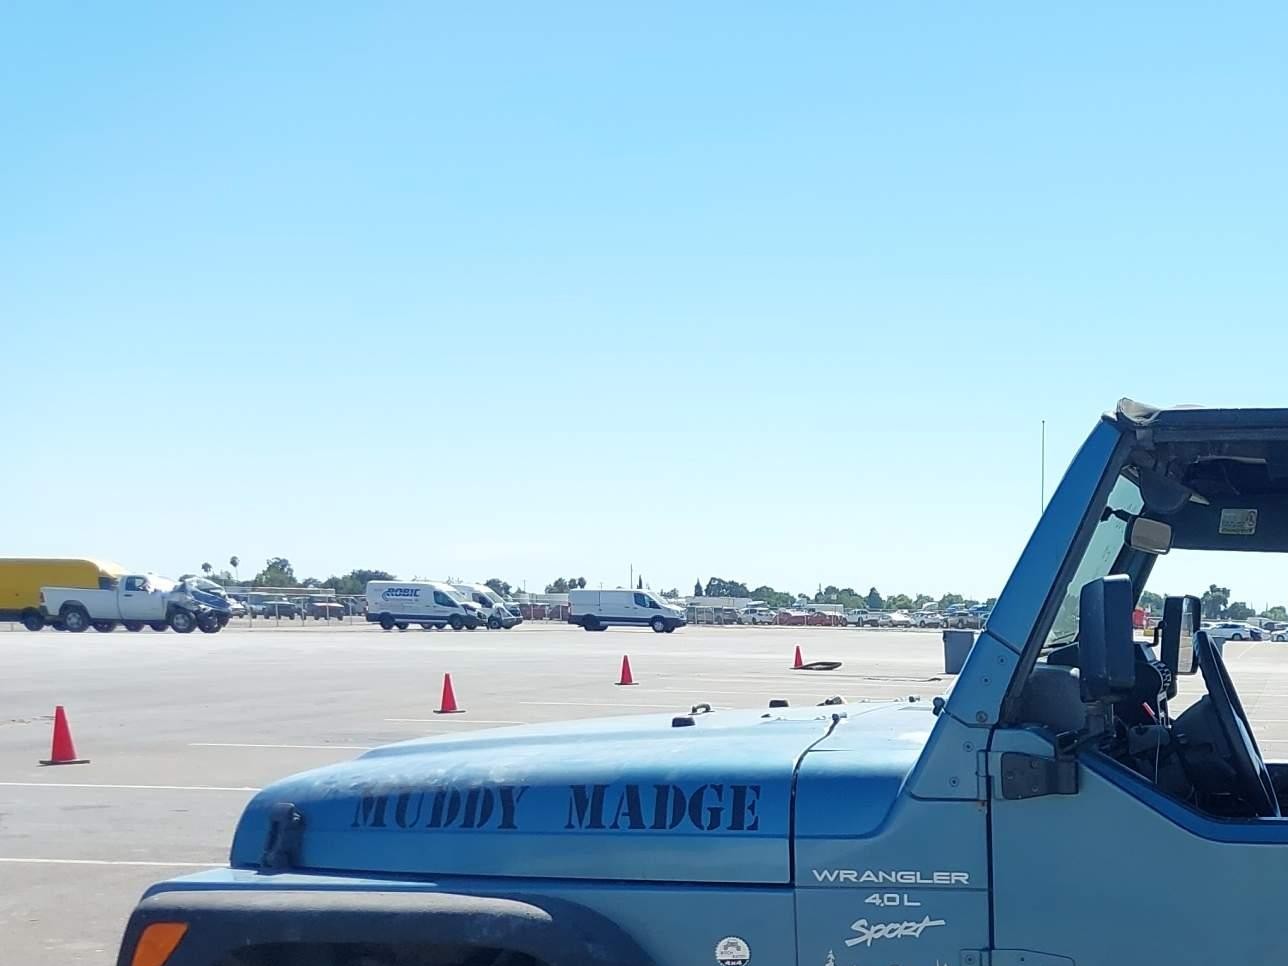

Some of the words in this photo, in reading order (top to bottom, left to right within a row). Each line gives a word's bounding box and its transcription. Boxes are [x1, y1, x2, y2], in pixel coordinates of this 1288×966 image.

[351, 784, 530, 829] MUDDY
[563, 784, 762, 831] MADGE
[812, 869, 970, 885] WRANGLER
